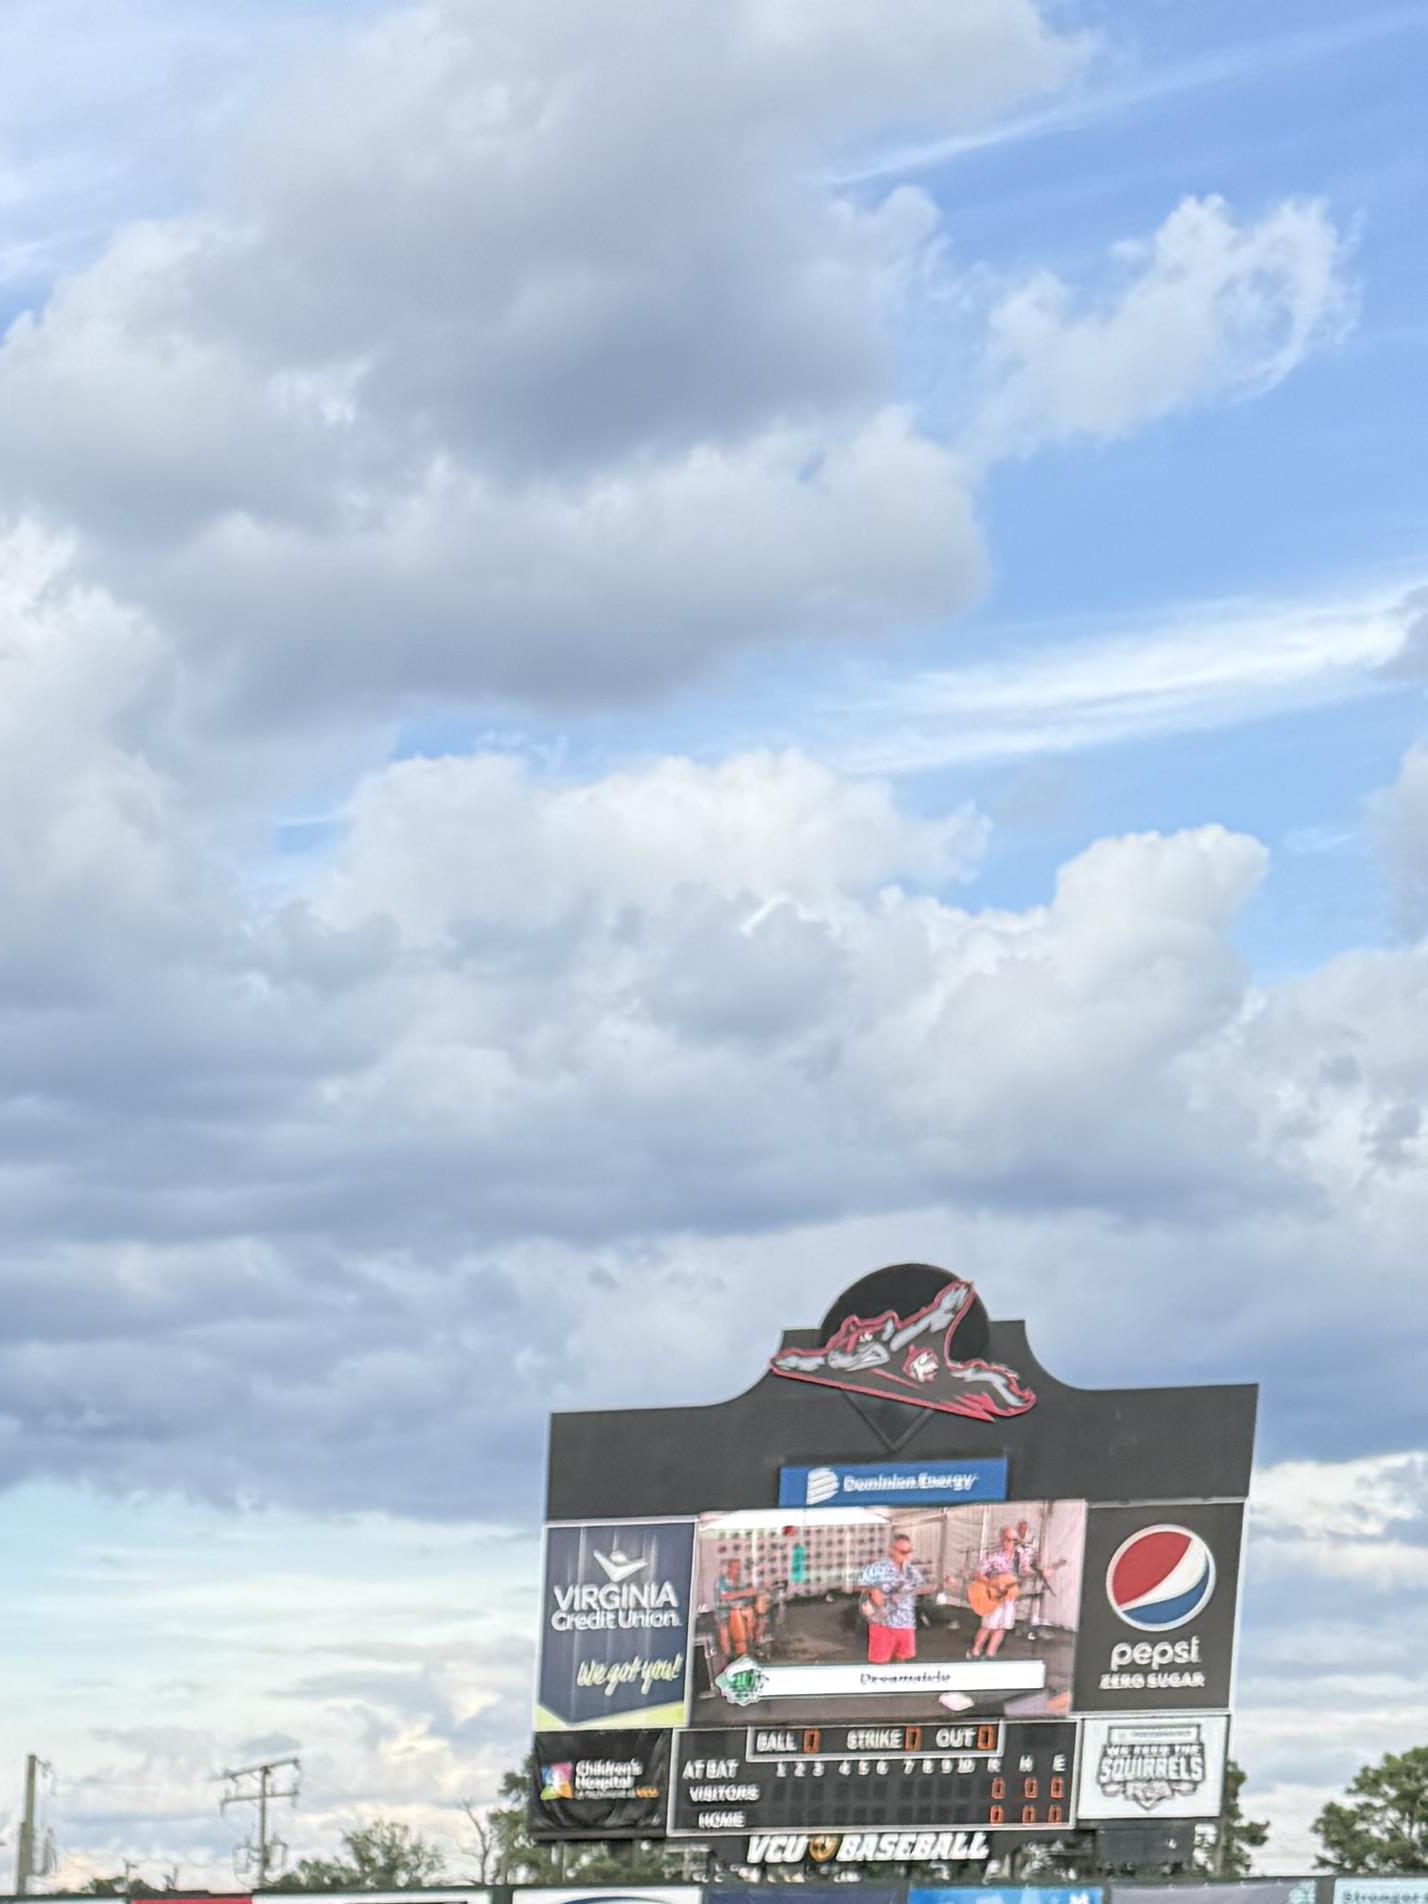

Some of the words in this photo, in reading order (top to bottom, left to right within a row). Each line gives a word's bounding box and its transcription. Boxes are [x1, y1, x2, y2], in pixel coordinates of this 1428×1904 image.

[843, 1474, 916, 1491] Dominion
[918, 1473, 977, 1491] Energy
[553, 1582, 679, 1611] VIRGINIA
[552, 1609, 617, 1631] Credit
[1110, 1635, 1201, 1671] pepsi
[577, 1660, 607, 1686] We
[605, 1655, 641, 1696] got
[1099, 1673, 1144, 1689] ZERO
[1147, 1672, 1205, 1688] SUGAR
[756, 1731, 796, 1751] BALL
[803, 1729, 820, 1754] 0
[847, 1730, 902, 1750] STRIKE
[905, 1727, 920, 1751] 0
[935, 1729, 976, 1748] OUT
[977, 1724, 994, 1750] 0
[575, 1758, 643, 1776] Children's
[683, 1760, 705, 1779] AT
[706, 1759, 739, 1778] BAT
[776, 1761, 786, 1778] 1
[795, 1760, 805, 1777] 2
[813, 1759, 824, 1776] 3
[839, 1759, 850, 1775] 4
[858, 1759, 870, 1775] 5
[877, 1758, 888, 1775] 6
[904, 1758, 915, 1775] 7
[922, 1758, 933, 1774] 8
[942, 1757, 952, 1774] 9
[958, 1757, 976, 1774] 10
[988, 1756, 1000, 1772] R
[1020, 1755, 1032, 1772] H
[1054, 1754, 1066, 1772] E
[1099, 1756, 1203, 1782] SQUIRRELS
[575, 1775, 634, 1792] Hospital
[690, 1785, 759, 1801] VISITORS
[992, 1777, 1005, 1799] 0
[1025, 1777, 1037, 1798] 0
[1051, 1776, 1063, 1797] 0
[699, 1811, 744, 1828] HOME
[989, 1805, 1004, 1823] 0
[1022, 1805, 1036, 1824] 0
[747, 1835, 809, 1863] VCU
[836, 1832, 990, 1862] BASEBALL
